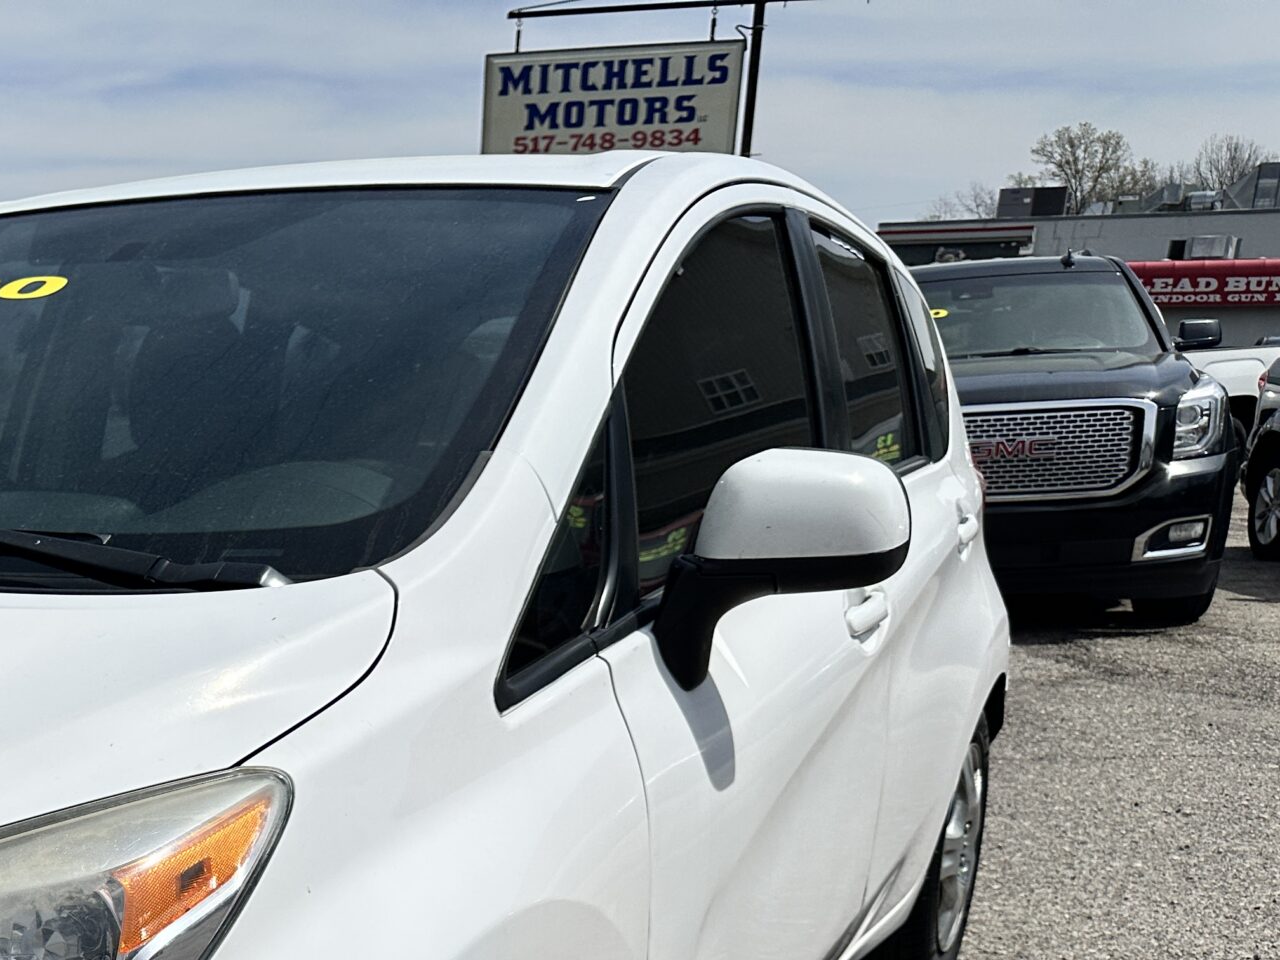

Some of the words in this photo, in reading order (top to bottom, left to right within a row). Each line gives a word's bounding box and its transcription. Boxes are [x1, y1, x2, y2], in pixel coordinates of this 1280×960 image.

[498, 53, 730, 96] MITCHELLS
[523, 95, 697, 131] MOTORS
[513, 127, 702, 154] 517-748-9834
[1227, 293, 1268, 302] GUN
[969, 438, 1056, 460] GMC
